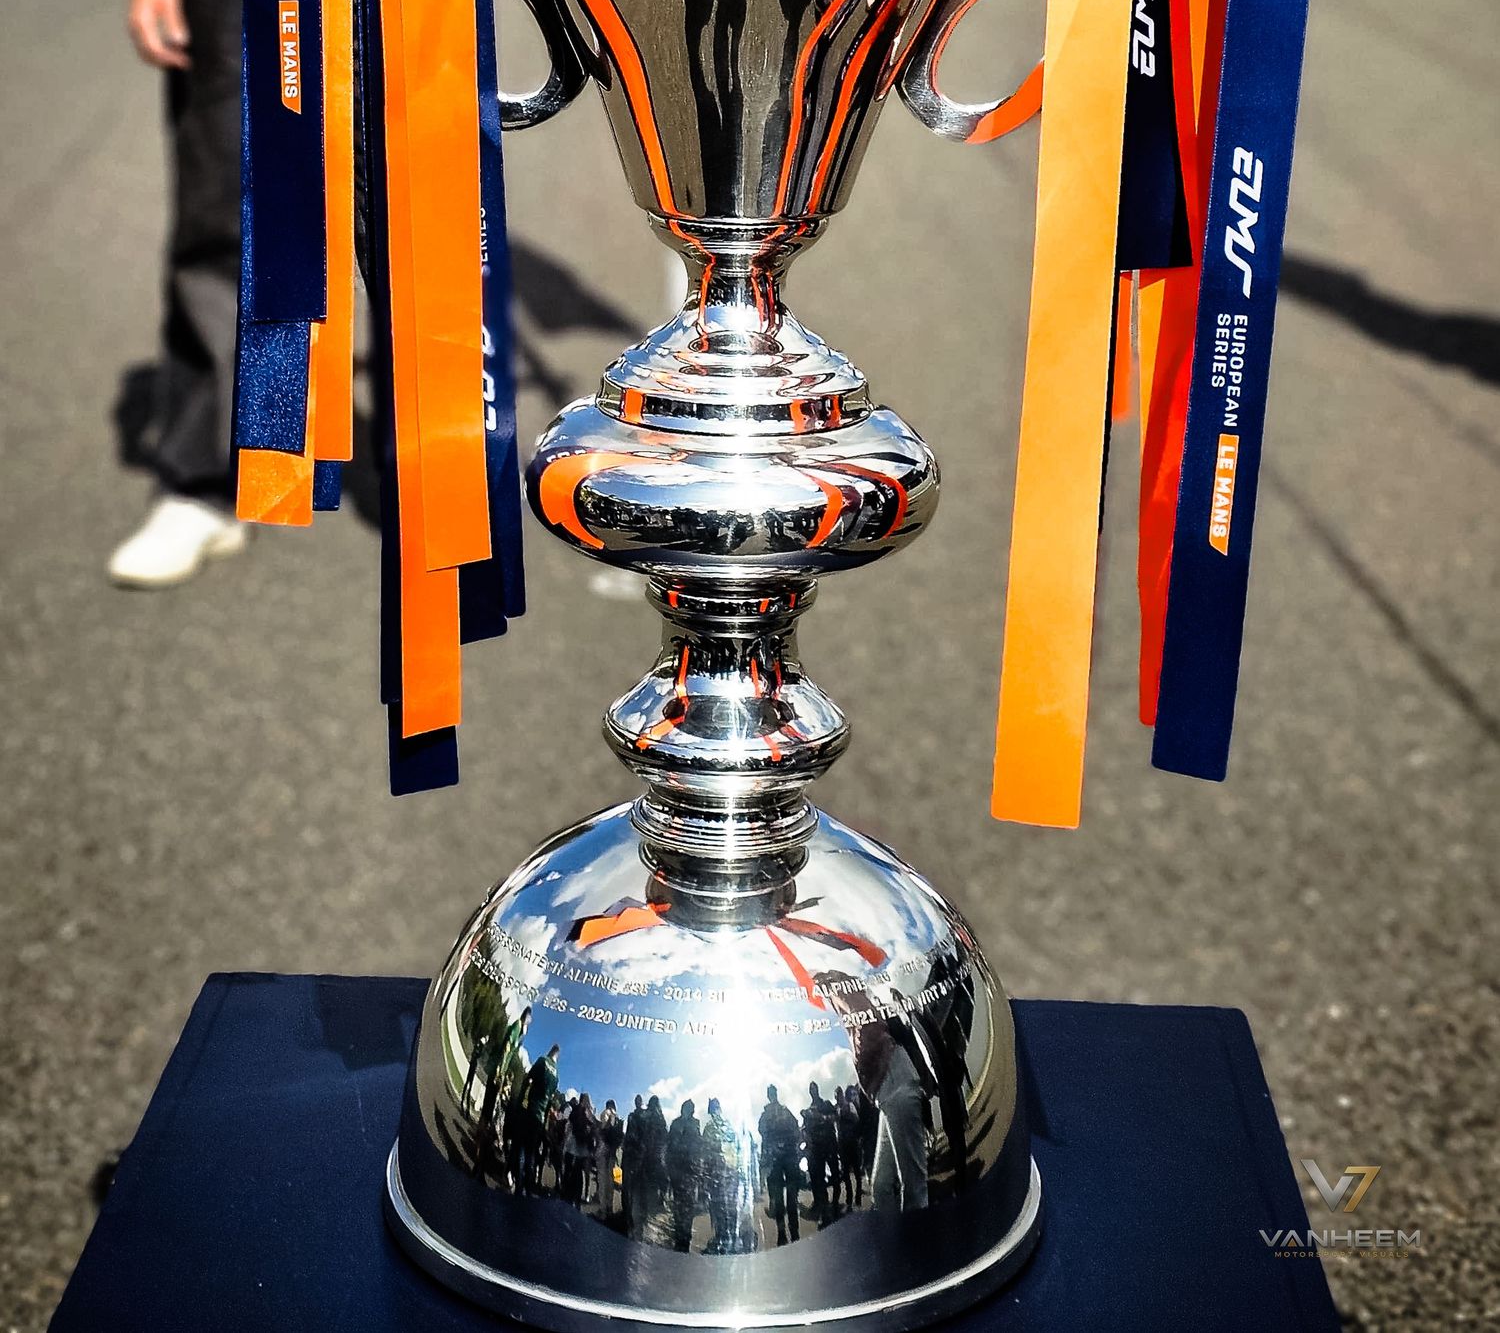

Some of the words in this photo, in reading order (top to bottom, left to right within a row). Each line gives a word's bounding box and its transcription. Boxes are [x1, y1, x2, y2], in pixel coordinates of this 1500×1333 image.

[281, 10, 296, 35] LE
[282, 41, 298, 99] MANS
[1211, 313, 1231, 389] SERIES
[1224, 314, 1248, 428] EUROPEAN
[1218, 444, 1235, 470] LE
[1211, 475, 1232, 539] MANS
[563, 967, 621, 996] ALPINE
[812, 976, 868, 999] ALPINE
[577, 1004, 613, 1025] 2020
[616, 1012, 678, 1034] UNITED
[842, 1008, 878, 1028] 2021
[876, 995, 915, 1021] TEAM
